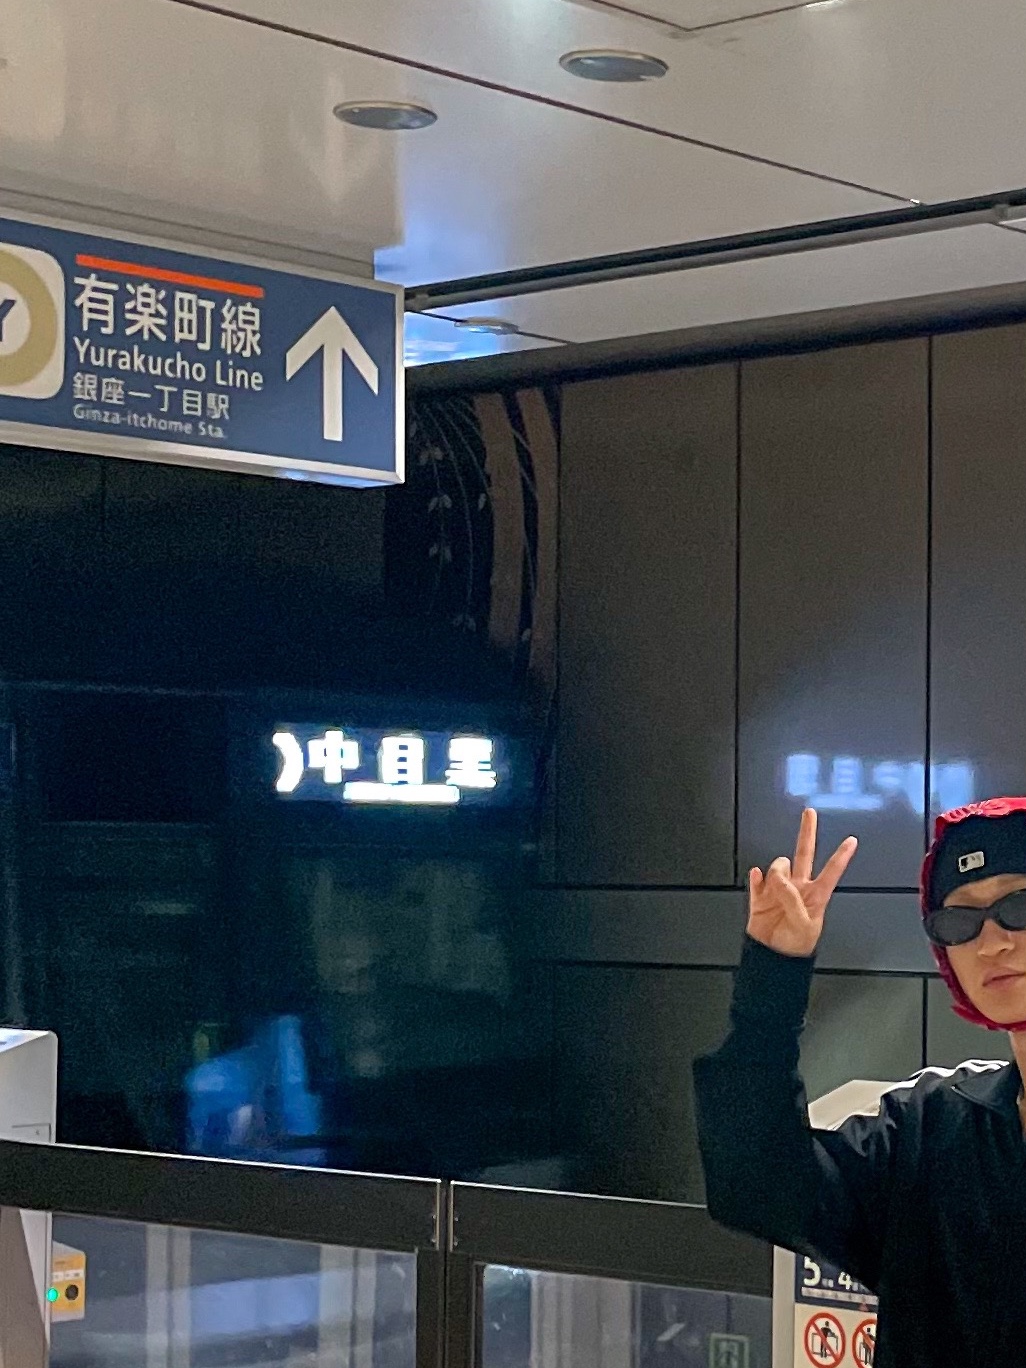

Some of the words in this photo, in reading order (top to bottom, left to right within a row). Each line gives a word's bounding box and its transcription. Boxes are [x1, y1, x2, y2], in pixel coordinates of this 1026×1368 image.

[73, 273, 263, 358] 有楽町線
[73, 336, 206, 382] Yurakucho
[215, 360, 264, 391] Line
[73, 372, 230, 420] 銀座一丁目駅
[73, 403, 194, 433] Ginza-itchome
